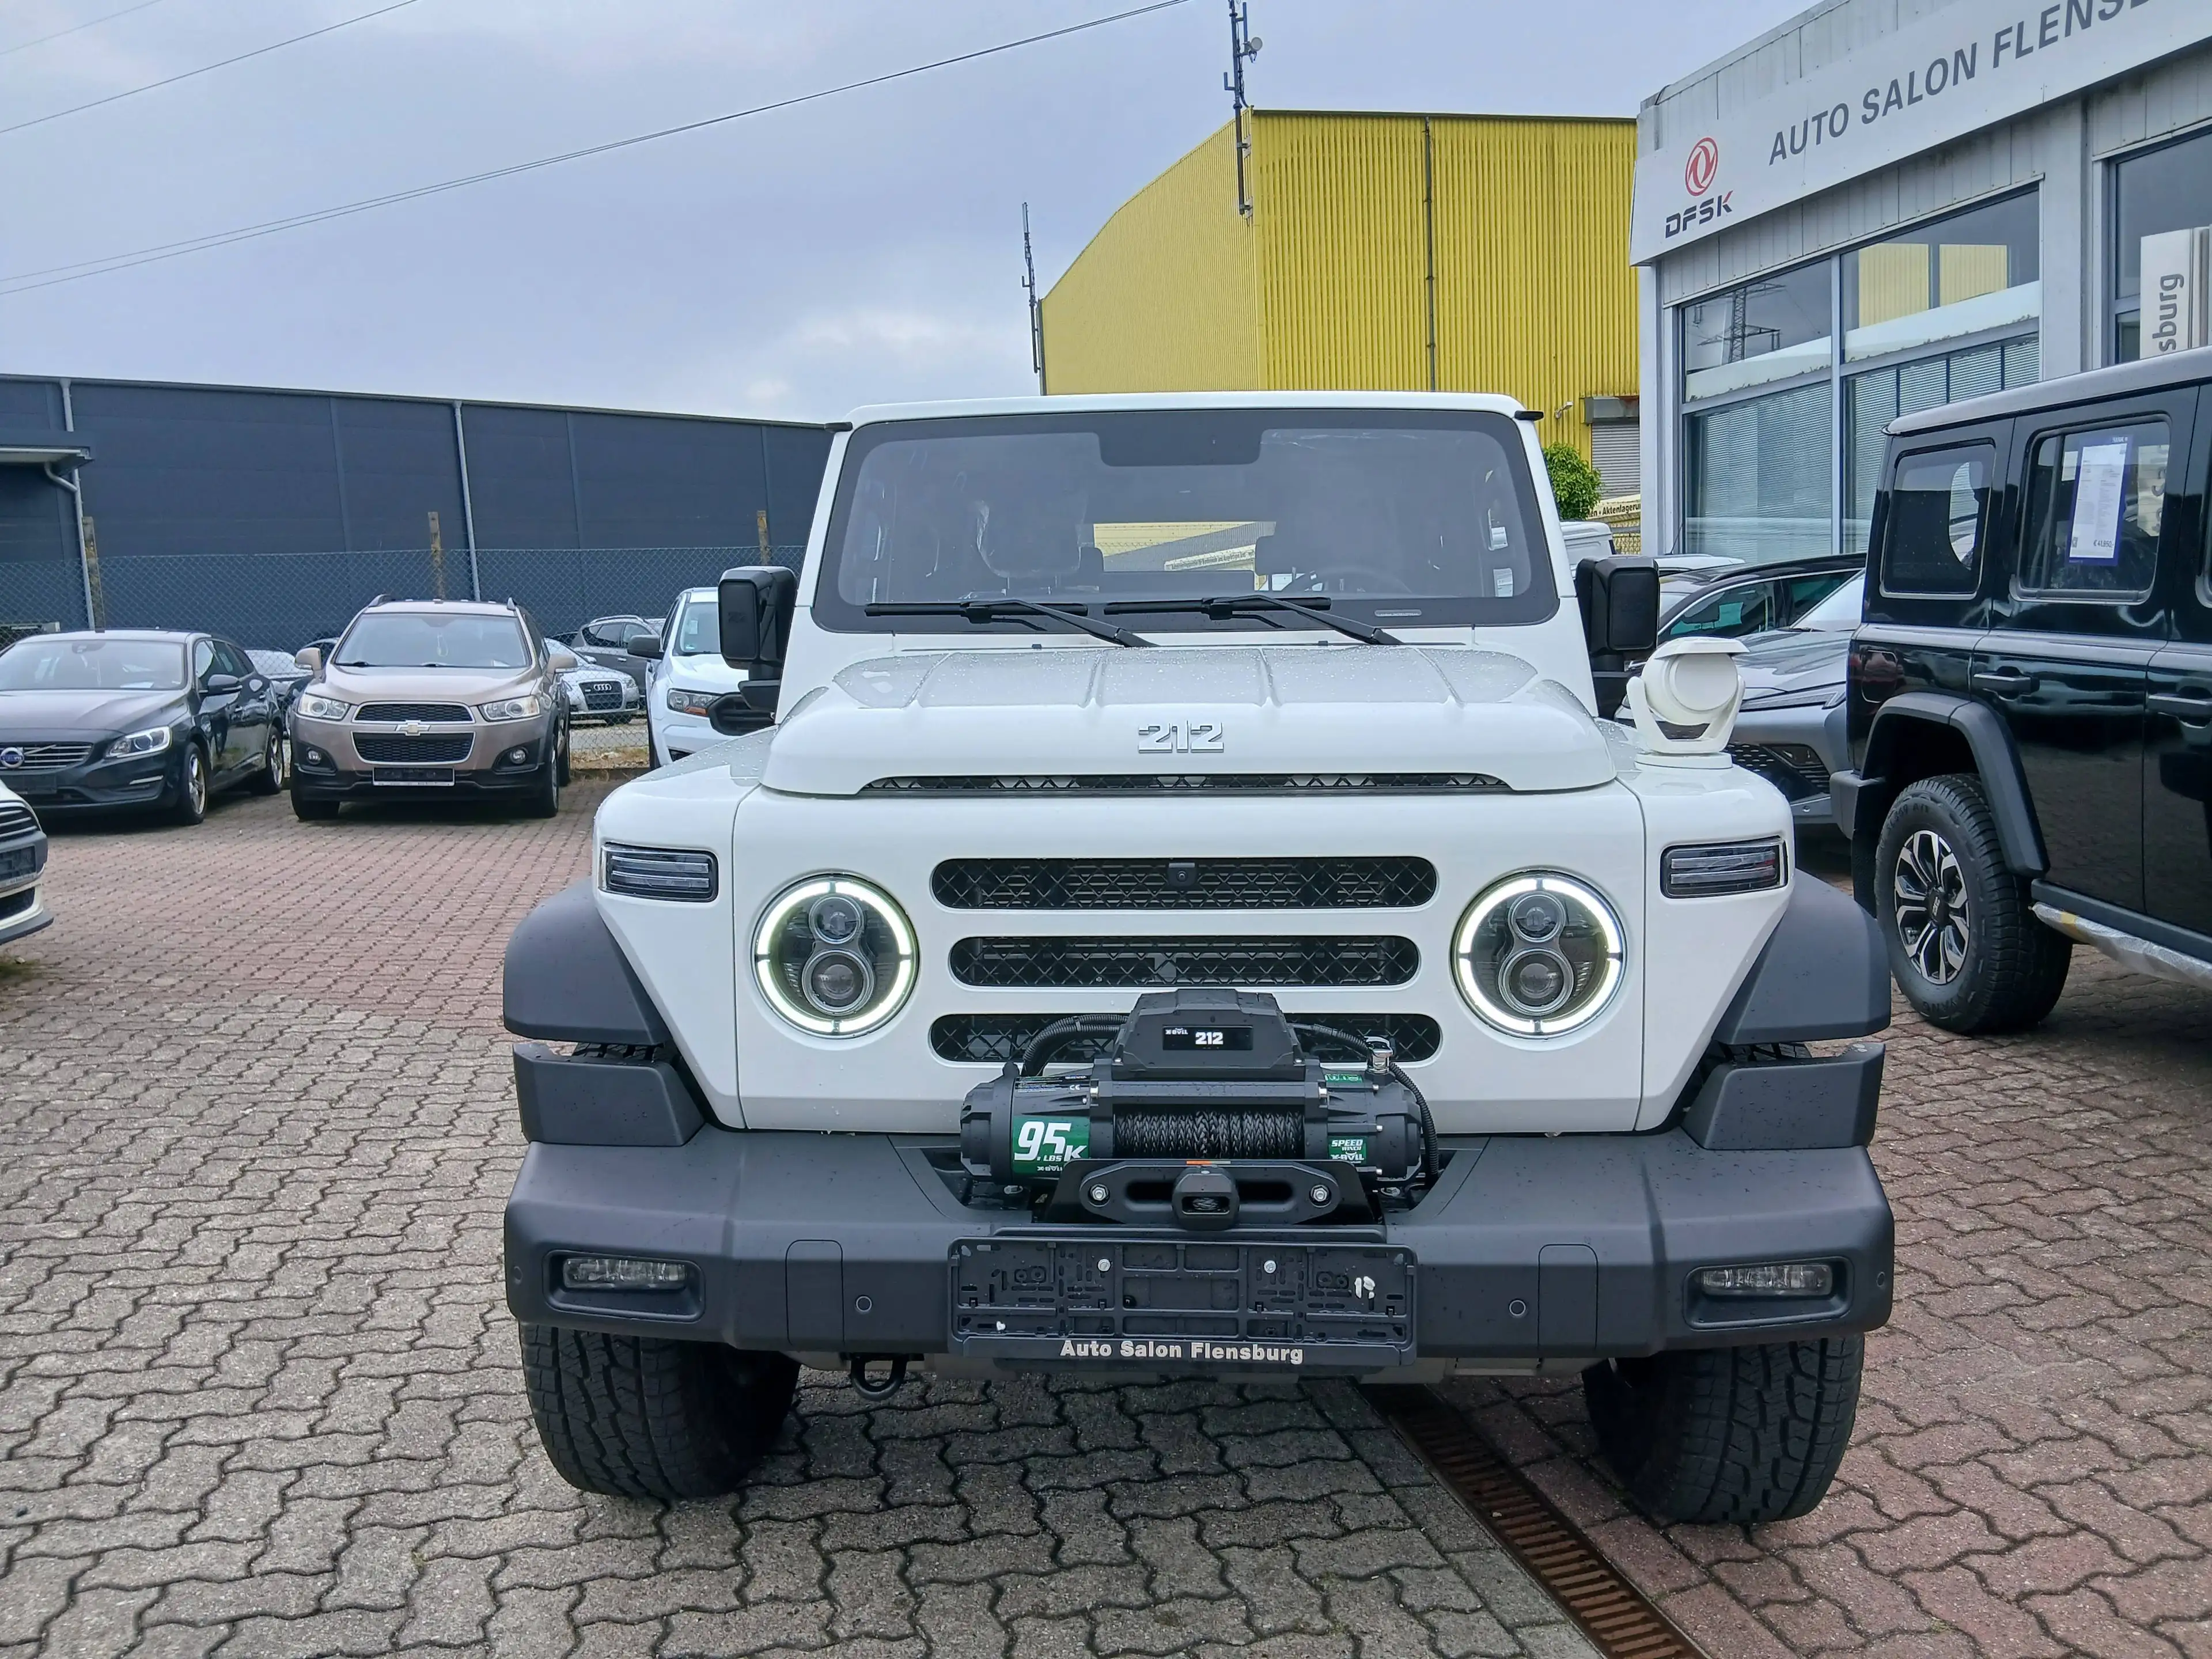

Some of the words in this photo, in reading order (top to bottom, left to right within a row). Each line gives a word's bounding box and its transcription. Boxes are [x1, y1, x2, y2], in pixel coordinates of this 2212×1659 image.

[1769, 103, 1849, 166] AUTO
[1861, 43, 1978, 124] SALON
[1665, 190, 1733, 238] DFSK
[1138, 721, 1224, 753] 212
[1195, 1032, 1224, 1045] 212
[1331, 1139, 1363, 1147] SPEED
[1060, 1340, 1112, 1358] Auto
[1120, 1340, 1182, 1358] Salon
[1191, 1342, 1303, 1365] Flensburg
